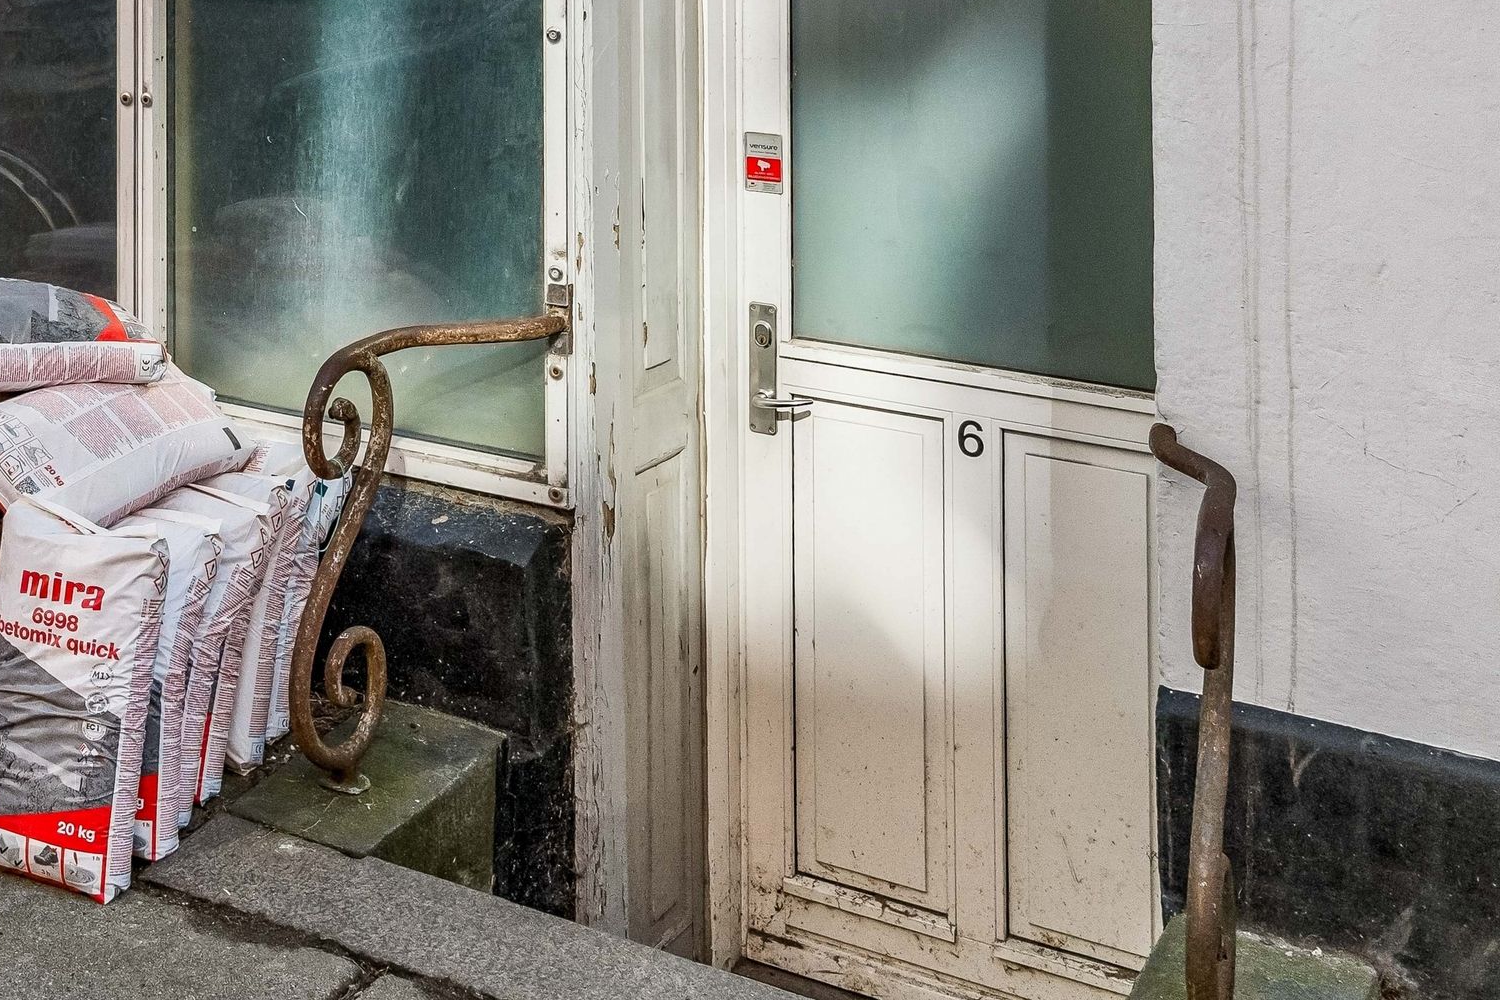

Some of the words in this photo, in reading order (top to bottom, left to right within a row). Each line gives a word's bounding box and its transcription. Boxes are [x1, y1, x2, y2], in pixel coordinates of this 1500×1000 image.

[957, 420, 985, 458] 6
[44, 464, 56, 475] 20
[54, 475, 65, 487] kg
[19, 569, 106, 612] mira
[32, 606, 79, 632] 6998
[66, 638, 121, 661] quick
[57, 820, 75, 836] 20
[77, 825, 96, 843] kg
